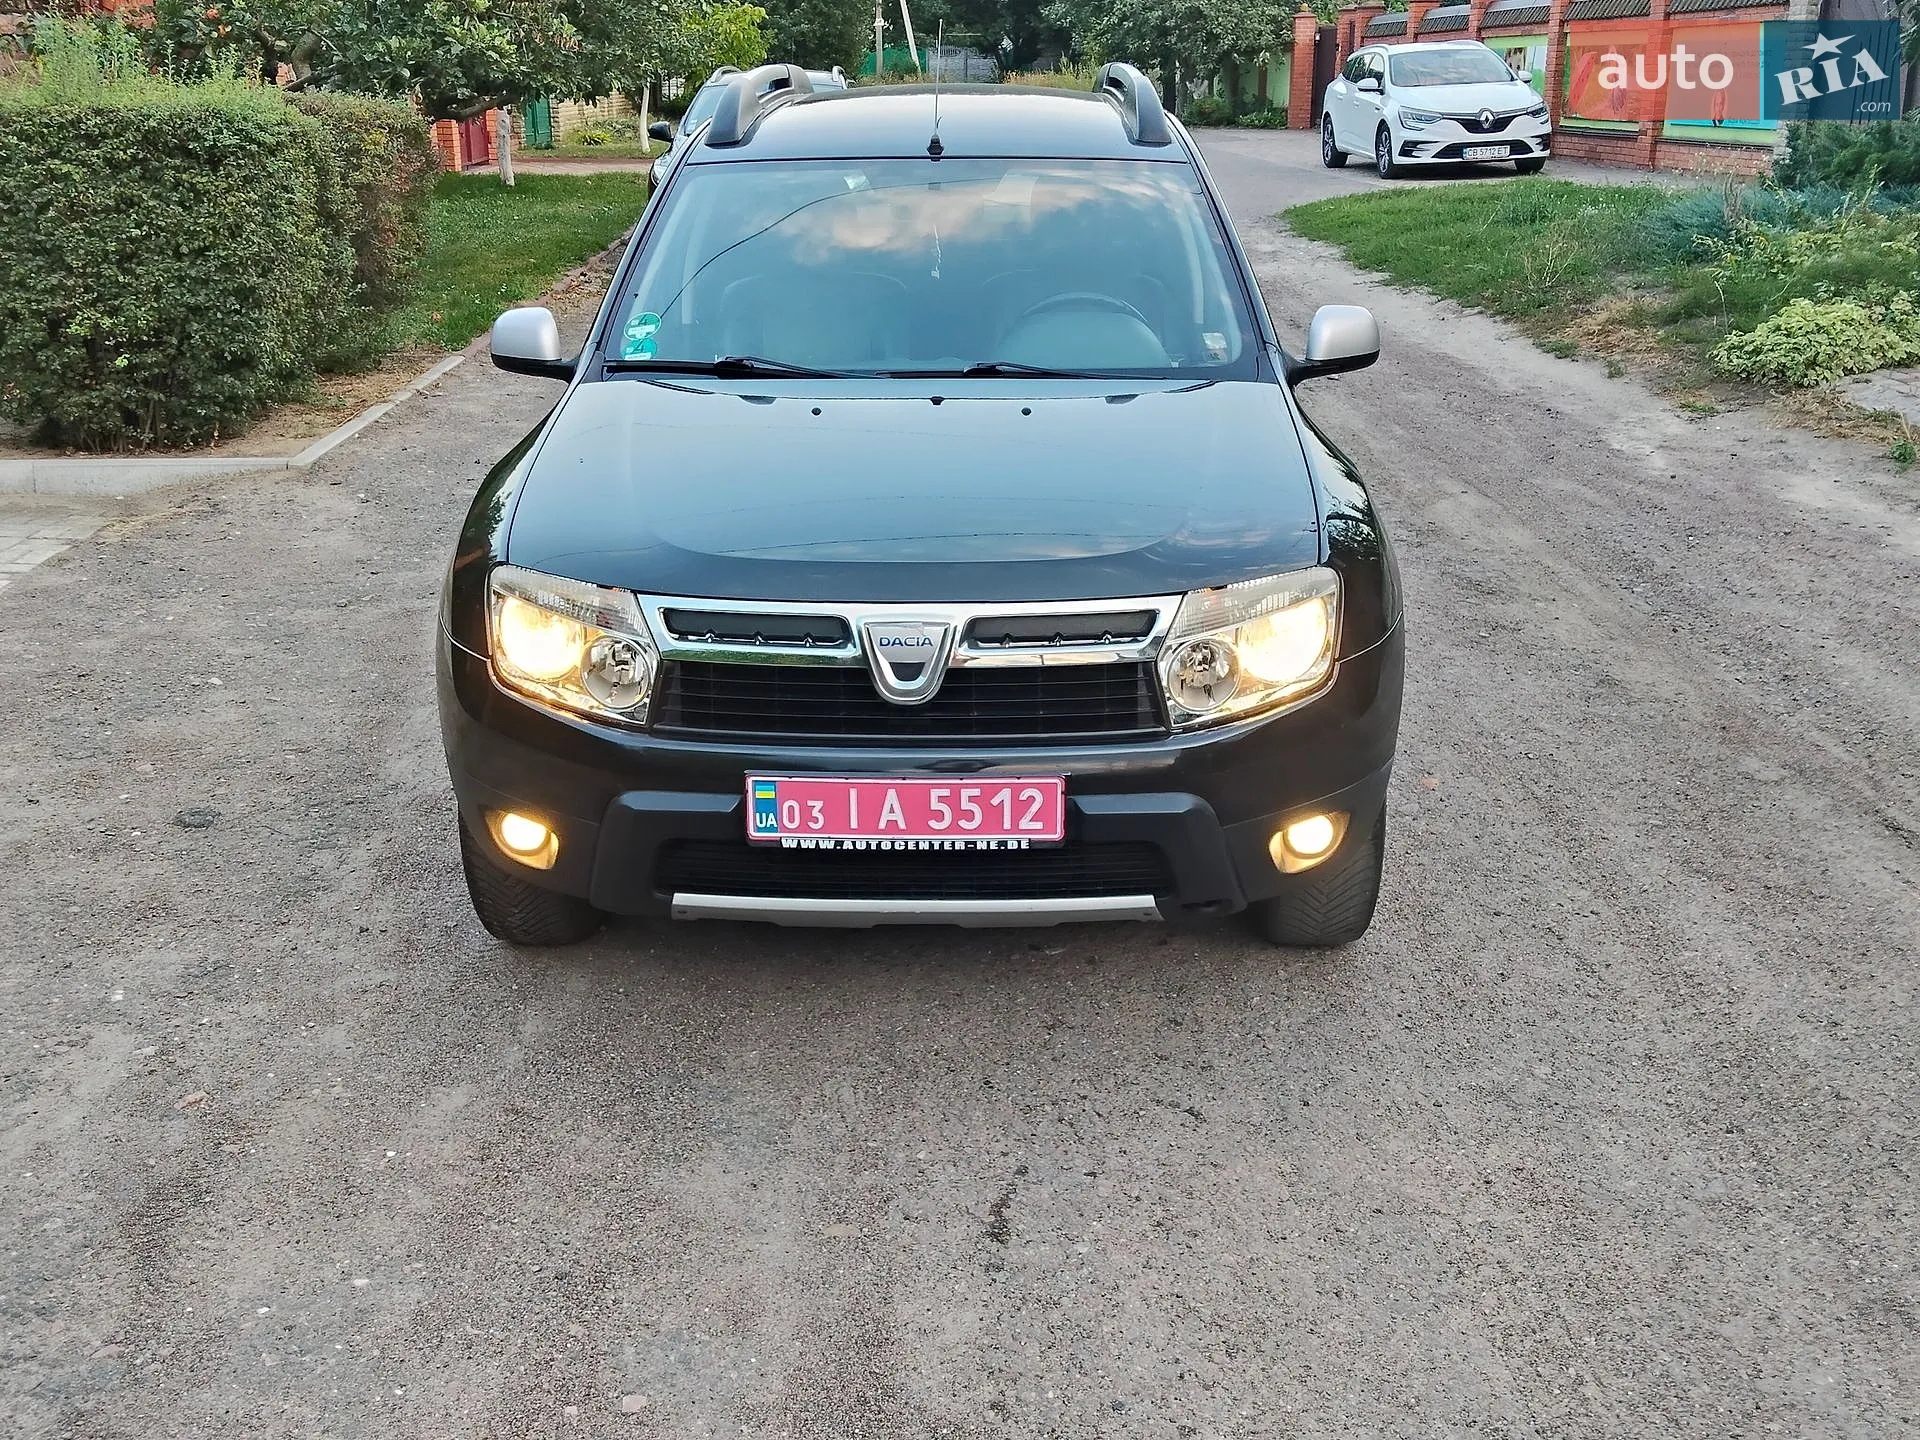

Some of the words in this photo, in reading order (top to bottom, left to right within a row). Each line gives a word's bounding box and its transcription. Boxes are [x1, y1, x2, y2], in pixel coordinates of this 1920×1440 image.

[1480, 148, 1496, 156] 5712
[879, 637, 934, 647] DACIA
[782, 800, 825, 830] 03
[928, 787, 1044, 831] 5512
[756, 813, 778, 828] UA
[781, 838, 1030, 850] WWW.AUTOCENTER-NE.DE
